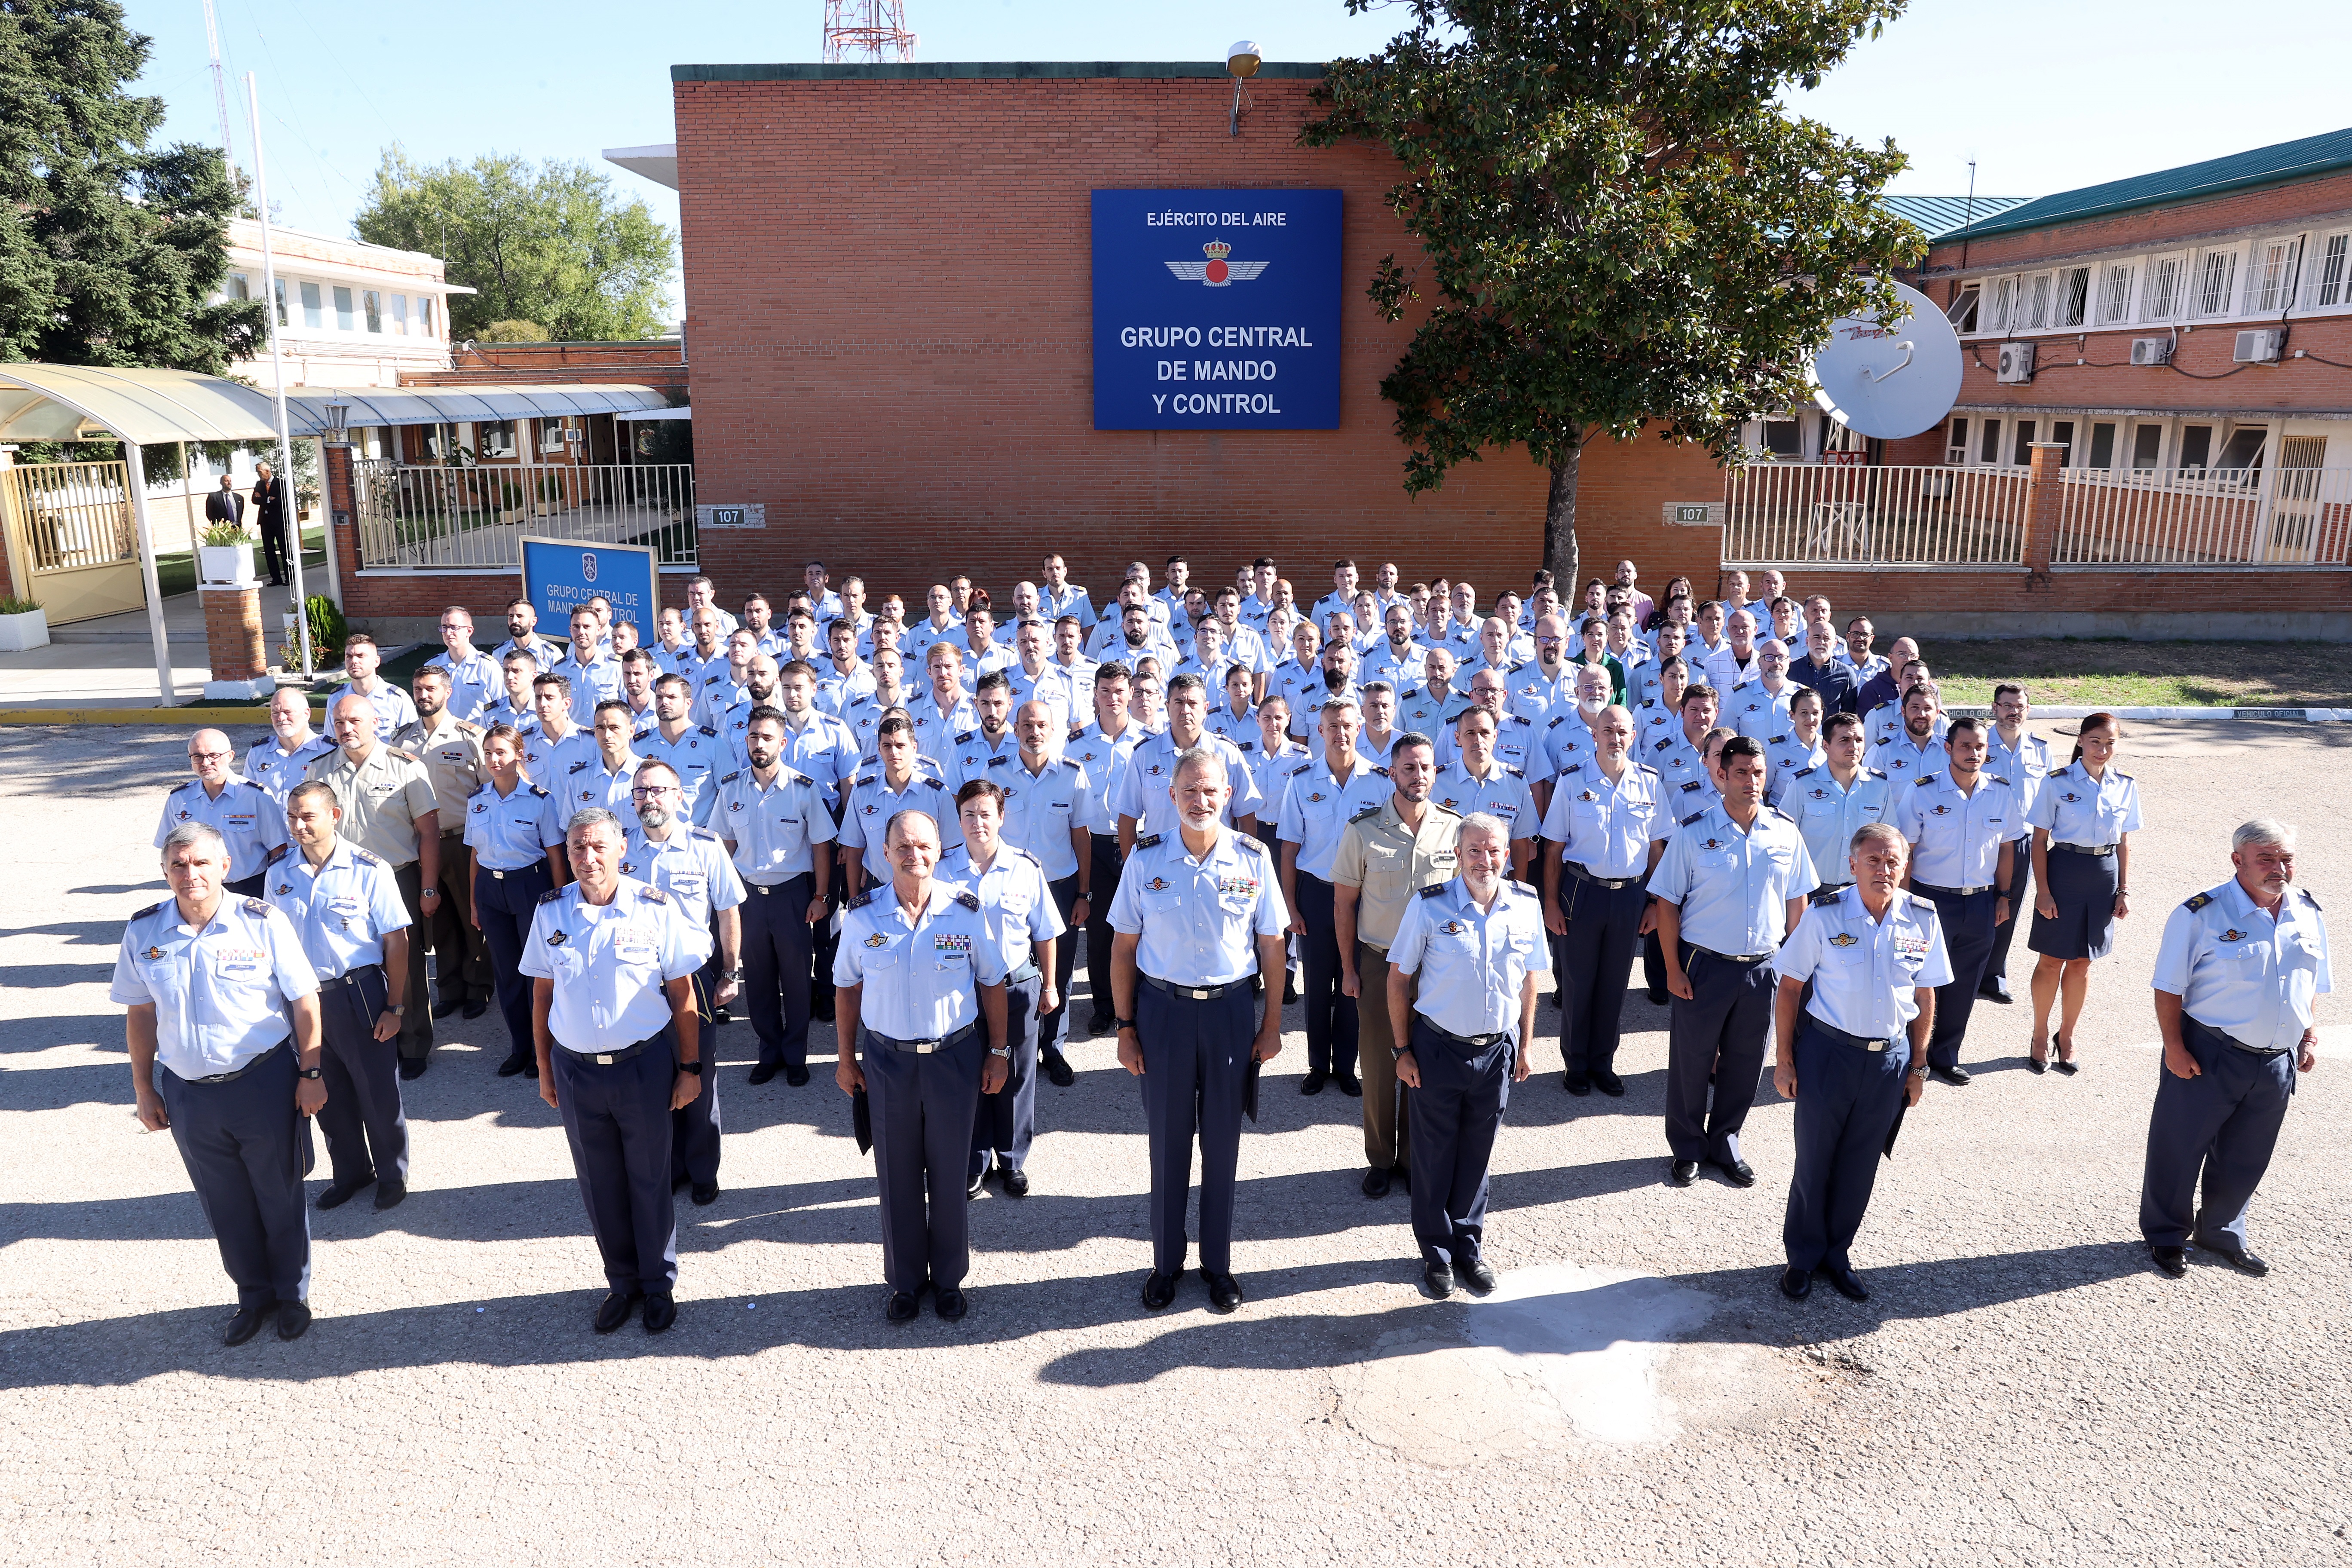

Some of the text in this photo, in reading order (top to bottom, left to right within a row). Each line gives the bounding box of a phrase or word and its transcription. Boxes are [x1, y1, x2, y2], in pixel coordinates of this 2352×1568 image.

[1147, 209, 1286, 226] EJÉRCITO DEL AIRE
[1121, 327, 1313, 347] GRUPO CENTRAL
[1158, 360, 1277, 380] DE MANDO
[1152, 393, 1281, 414] Y CONTROL
[718, 510, 739, 523] 107
[1682, 508, 1703, 521] 107
[546, 584, 639, 606] GRUPO CENTRAL DE
[548, 600, 579, 616] MAND
